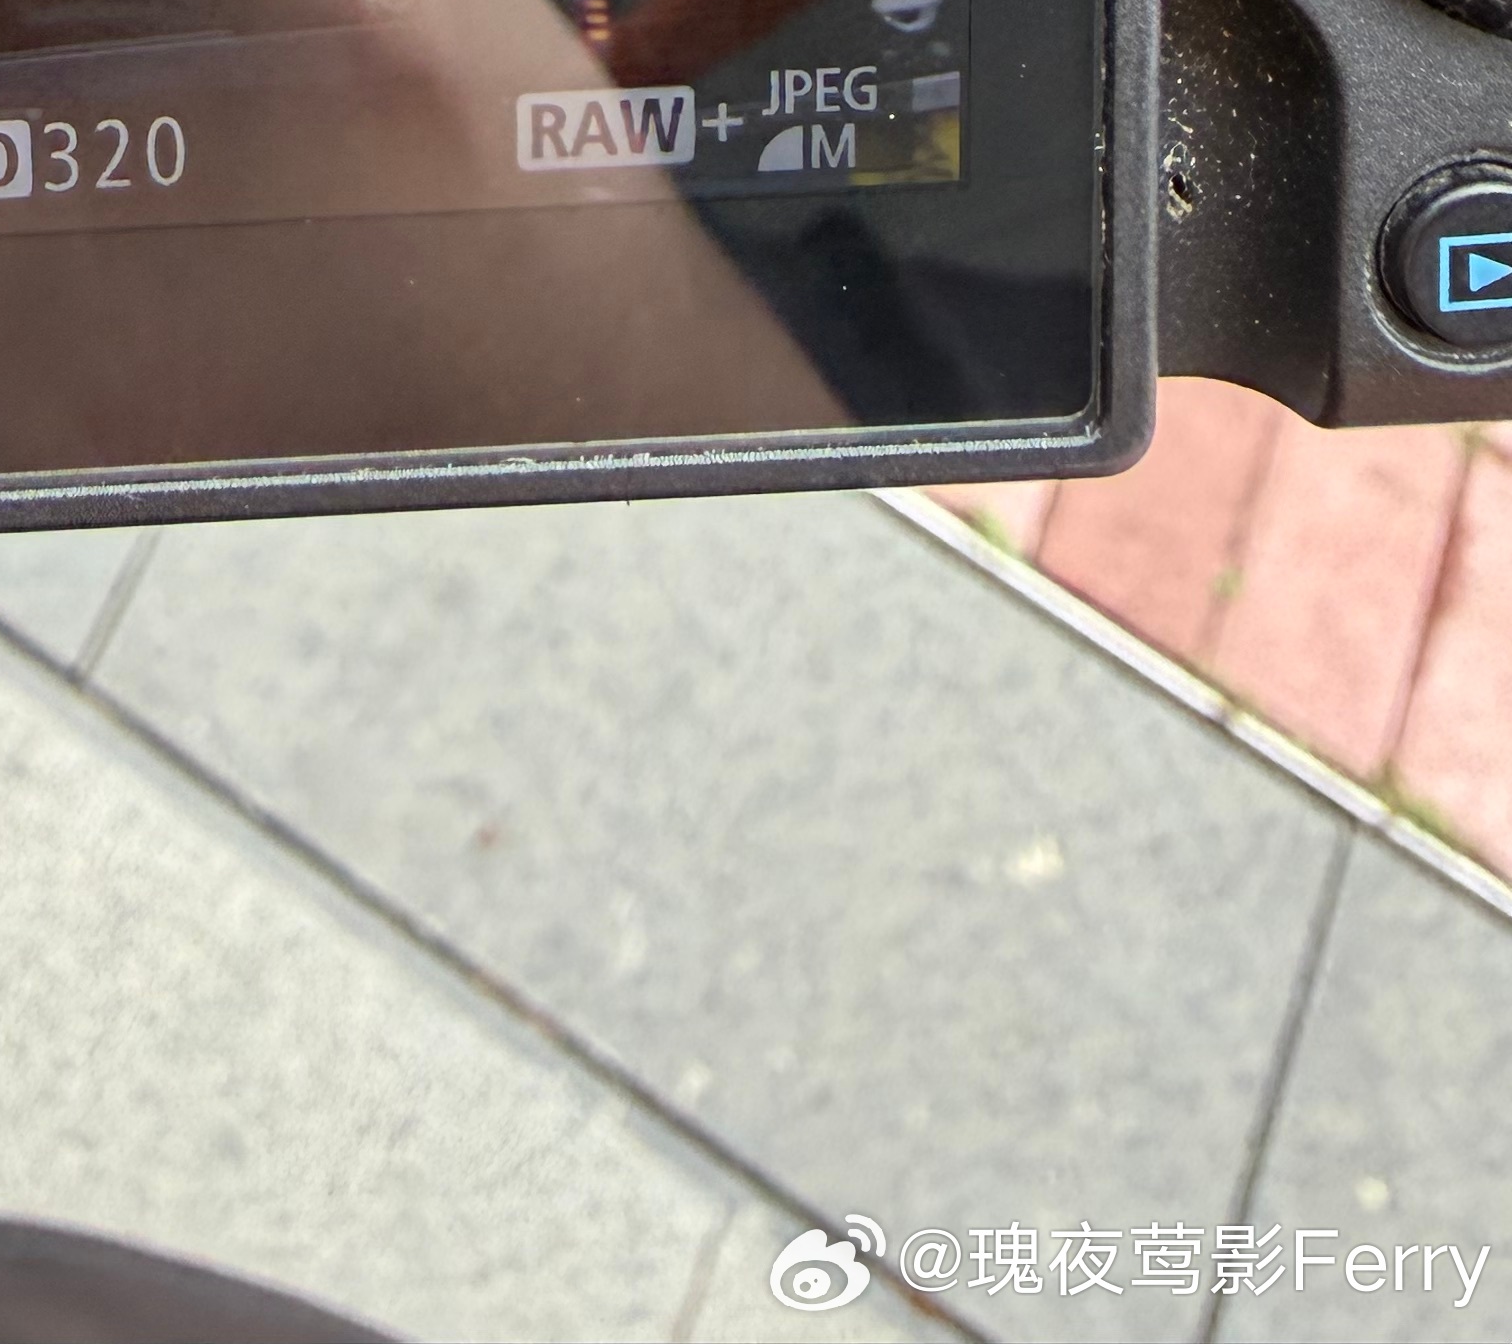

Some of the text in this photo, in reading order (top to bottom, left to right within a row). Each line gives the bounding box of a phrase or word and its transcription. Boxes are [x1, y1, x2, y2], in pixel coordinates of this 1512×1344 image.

[762, 66, 878, 115] JPEG
[42, 115, 186, 193] 320
[529, 97, 685, 159] RAW
[810, 123, 856, 168] M
